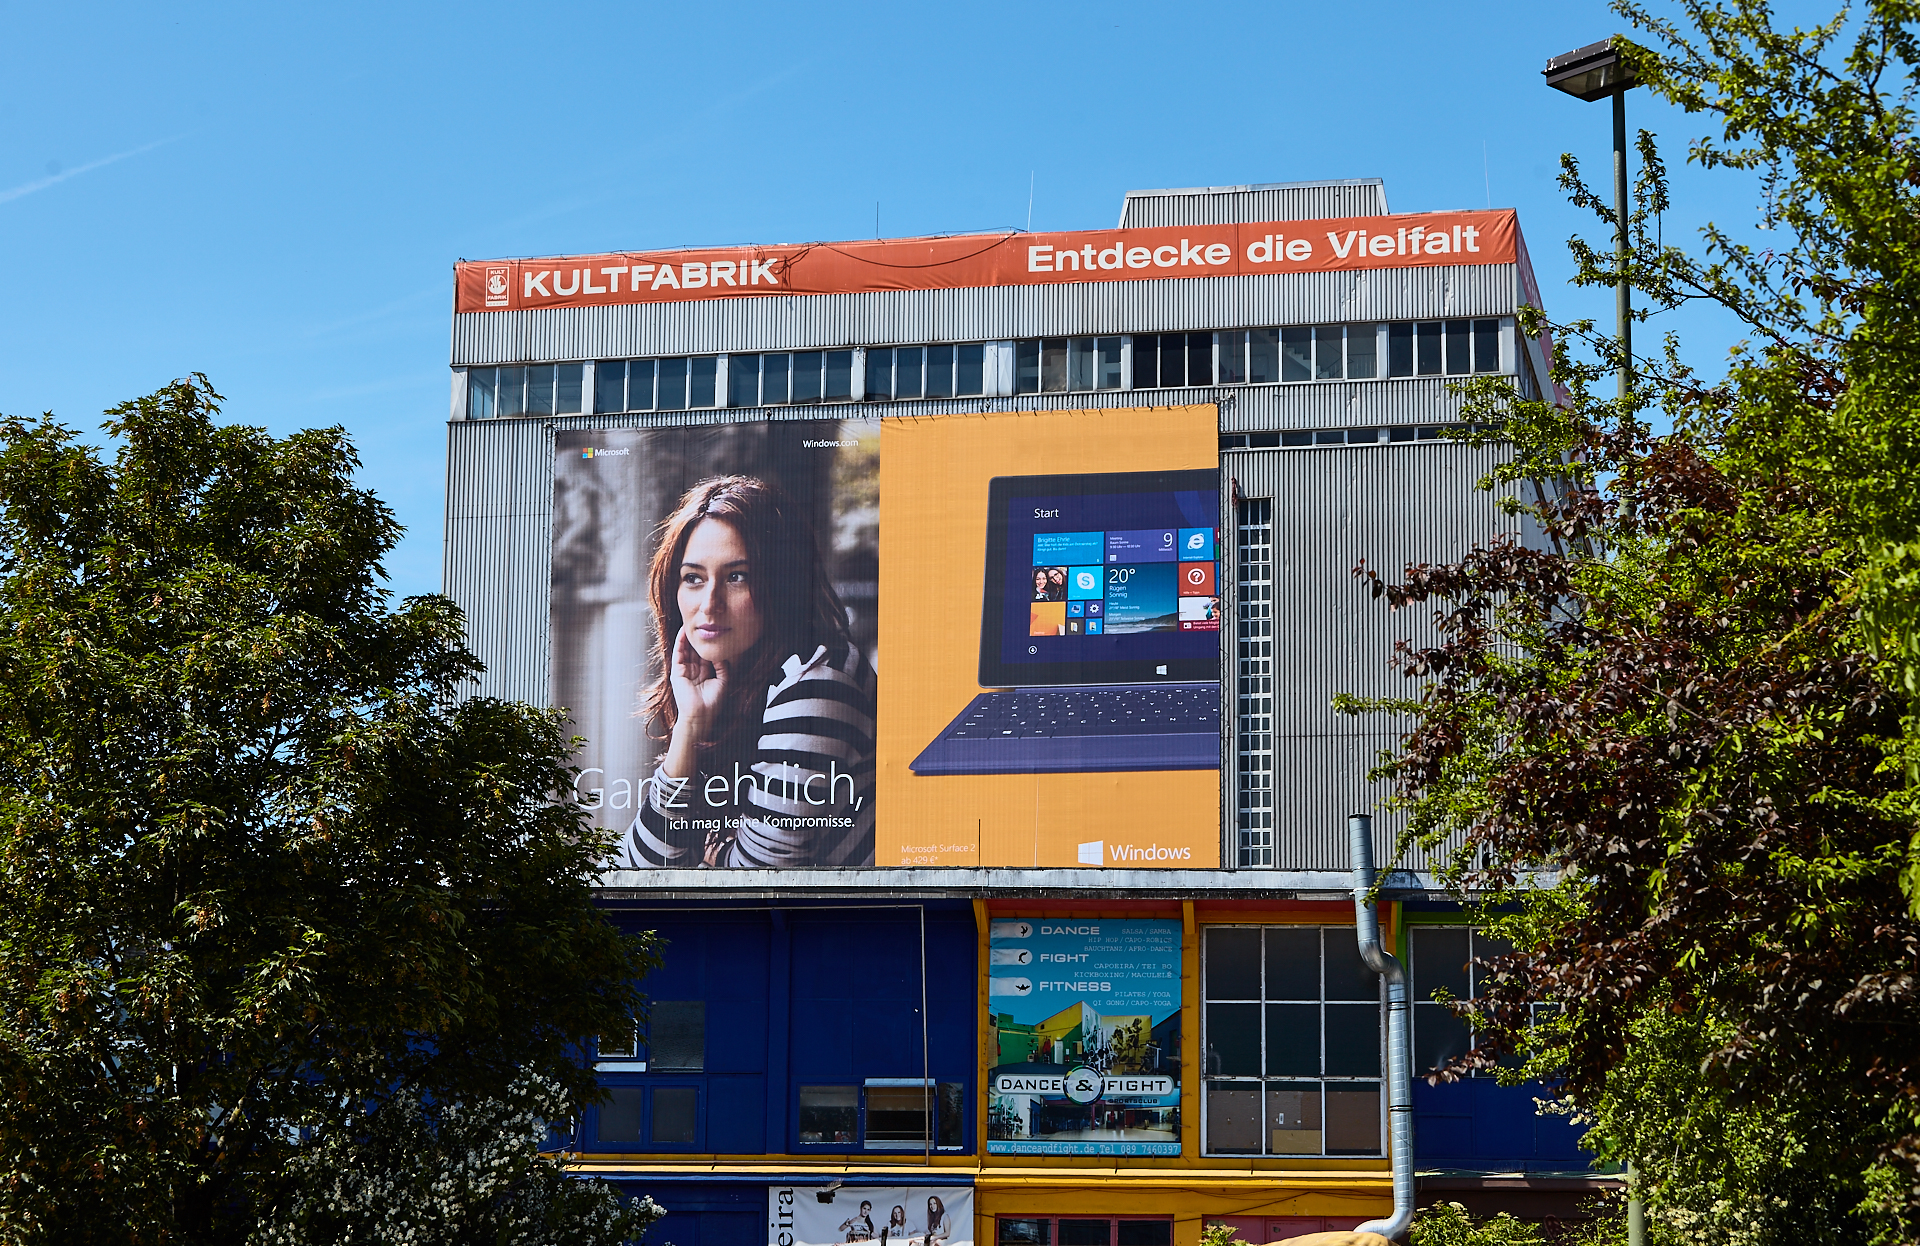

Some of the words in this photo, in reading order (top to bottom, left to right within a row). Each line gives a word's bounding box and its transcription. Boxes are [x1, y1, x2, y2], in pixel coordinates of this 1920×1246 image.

[1028, 238, 1231, 273] Entdecke
[1246, 234, 1312, 264] die
[1326, 225, 1480, 259] Vielfalt
[524, 258, 778, 298] KULTFABRIK
[803, 438, 859, 448] Windows.com
[595, 447, 629, 457] Microsoft
[1034, 508, 1059, 518] Start
[1163, 532, 1173, 547] 9
[1109, 568, 1136, 584] 20°
[573, 768, 690, 811] Ganz
[704, 761, 863, 812] ehrlich,
[669, 817, 688, 831] ich
[692, 818, 721, 832] mag
[724, 815, 760, 829] keine
[763, 814, 855, 831] Kompromisse.
[901, 842, 938, 854] Microsoft
[939, 842, 969, 853] Surface
[970, 842, 976, 852] 2
[1110, 844, 1191, 861] Windows
[901, 857, 911, 865] ab
[913, 856, 928, 865] 429
[1040, 926, 1100, 935] DANCE
[1040, 953, 1089, 963] FIGHT
[1039, 981, 1112, 992] FITNESS
[1001, 1079, 1061, 1091] DANCE
[1075, 1079, 1093, 1092] &
[1107, 1080, 1167, 1092] FIGHT
[990, 1143, 1095, 1154] www.danceandfight.de
[1100, 1144, 1115, 1154] Tel
[1120, 1145, 1136, 1154] 089
[1142, 1145, 1178, 1154] 7460397
[771, 1187, 794, 1246] eira
